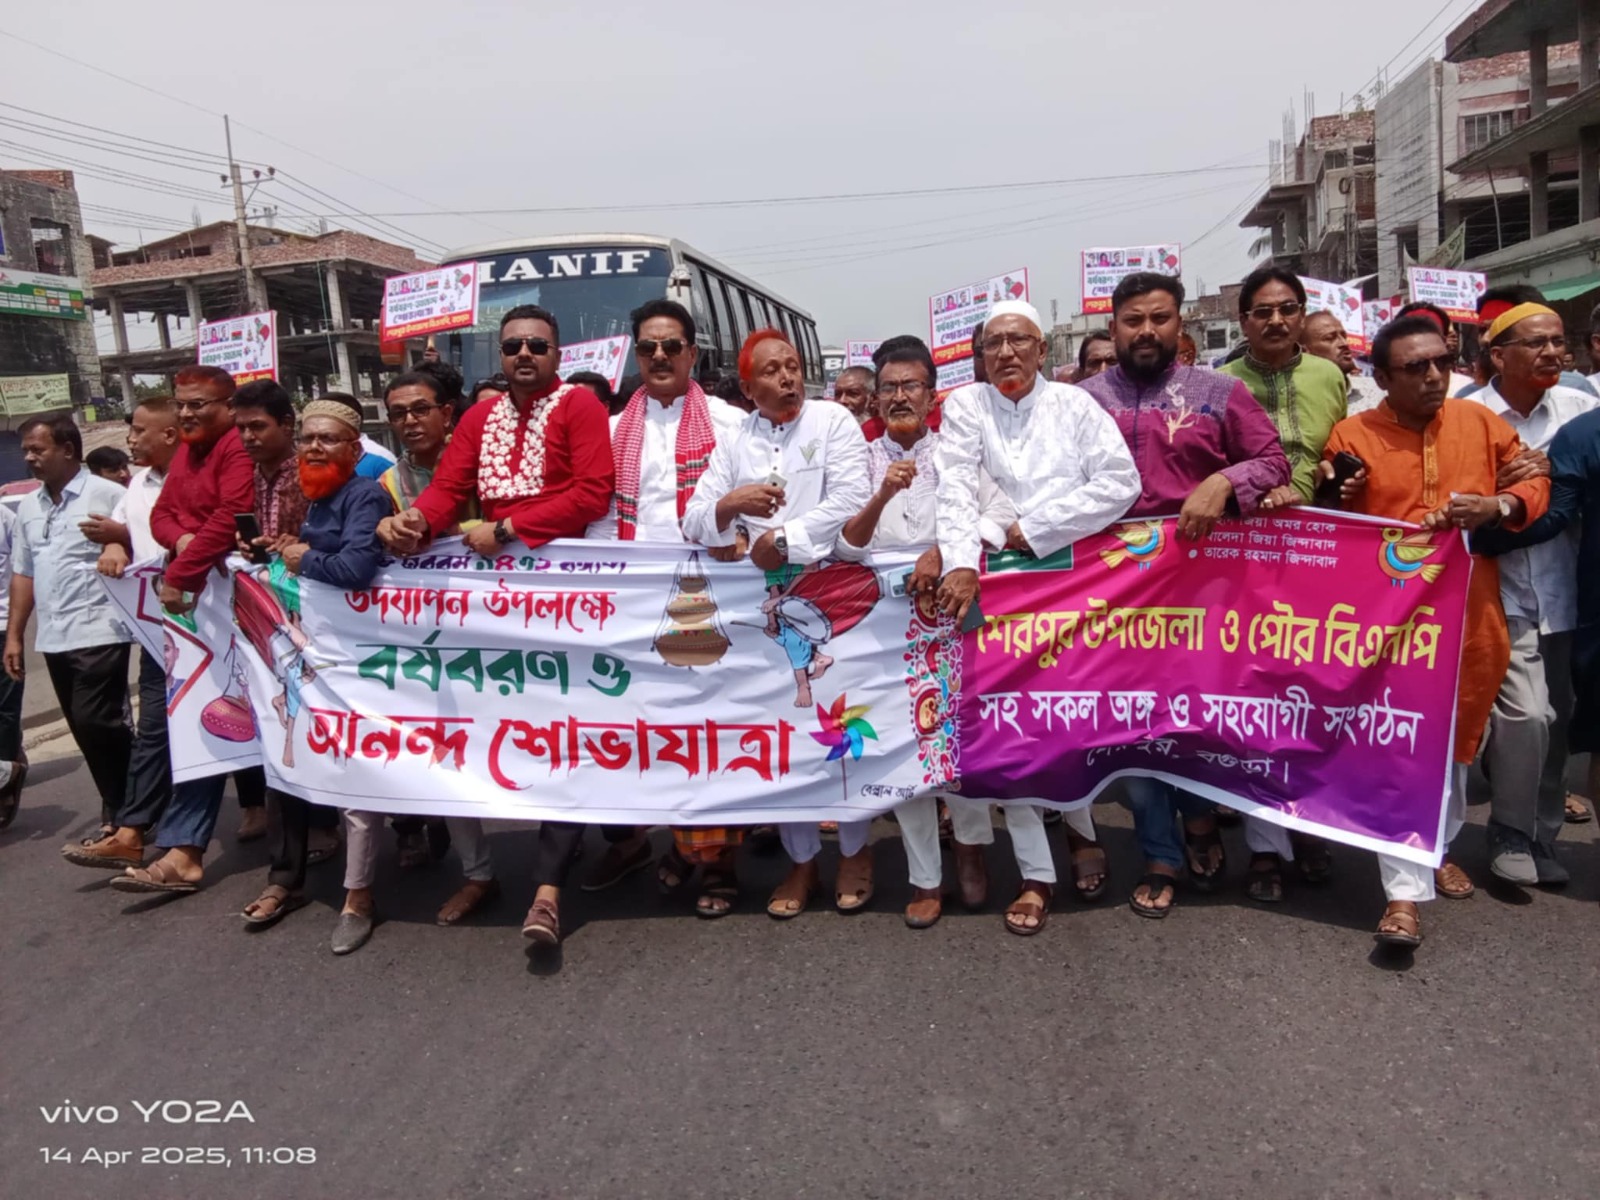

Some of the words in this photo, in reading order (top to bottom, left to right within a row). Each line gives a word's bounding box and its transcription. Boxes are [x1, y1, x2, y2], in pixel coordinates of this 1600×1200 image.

[1204, 547, 1240, 559] তারেক
[1244, 549, 1282, 563] রহমান
[483, 578, 617, 633] উপলক্ষে
[977, 611, 1080, 668] শেরপুর
[1082, 597, 1206, 651] উপজেলা
[1220, 609, 1240, 653] ও
[1248, 600, 1319, 666] পৌর
[1323, 603, 1442, 670] বিএনপি
[356, 630, 569, 696] বর্ষবরণ
[587, 652, 632, 698] ও
[306, 707, 474, 772] আনন্দ
[488, 714, 797, 791] শোভাযাত্রা
[978, 692, 1024, 737] সহ
[1028, 690, 1102, 731] সকল
[1108, 690, 1158, 730] অঙ্গ
[1167, 694, 1190, 728] ও
[1200, 685, 1316, 743] সহযোগী
[1322, 686, 1425, 755] সংগঠন
